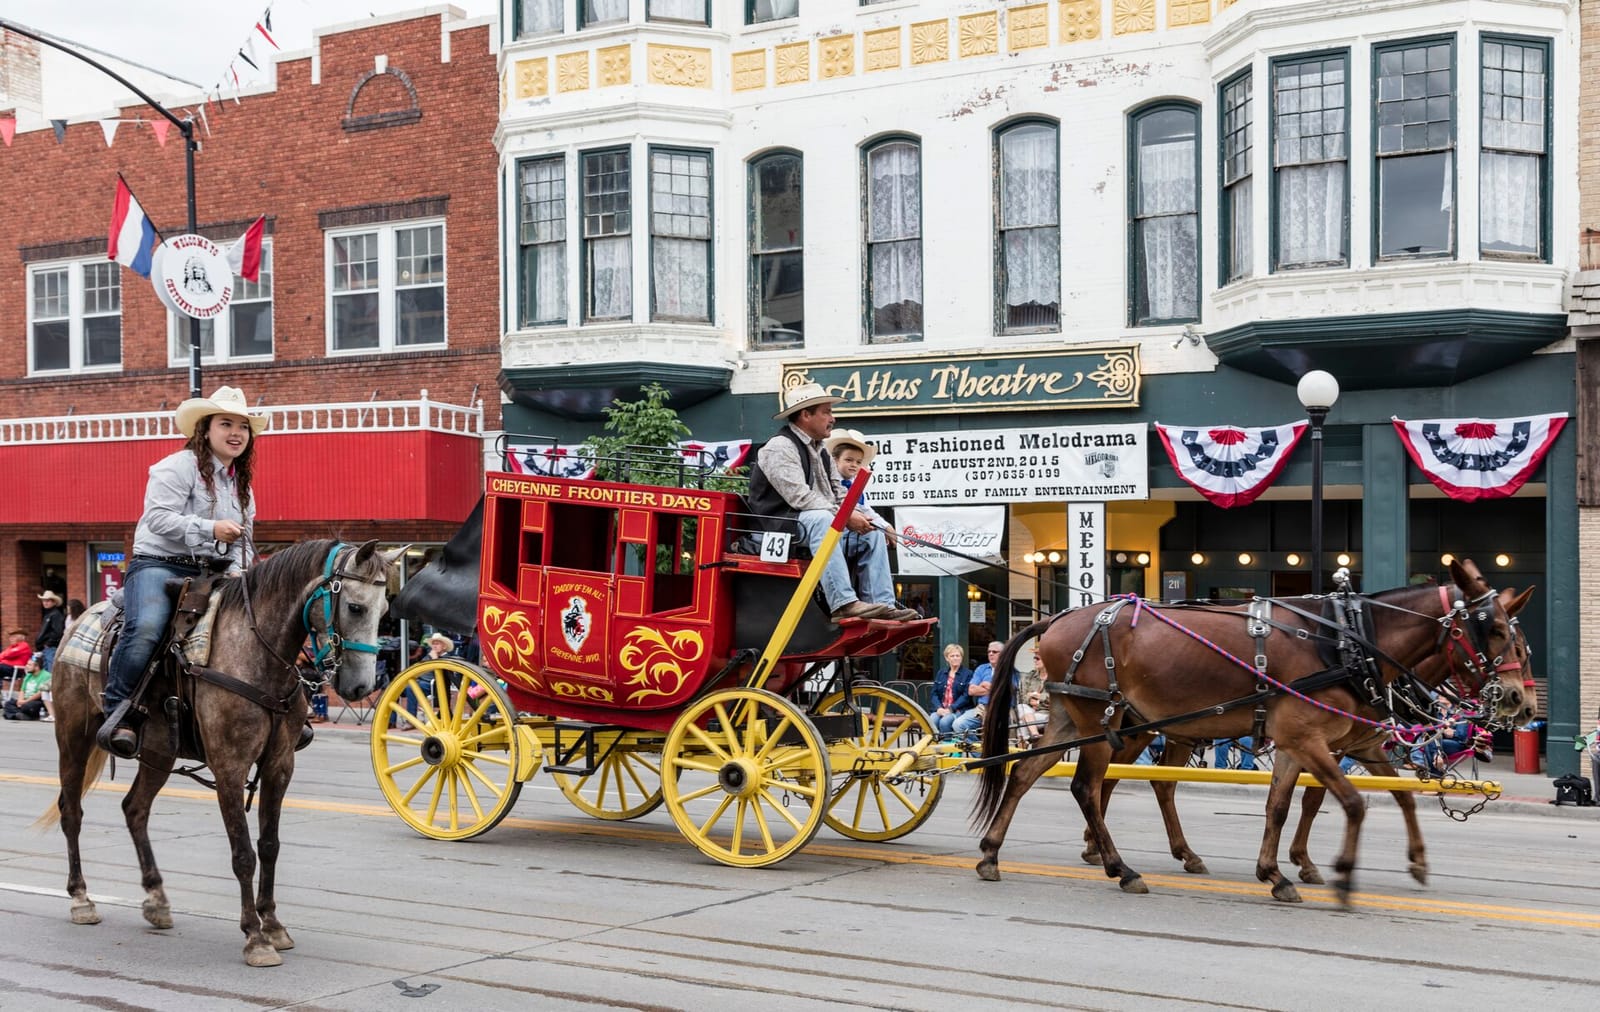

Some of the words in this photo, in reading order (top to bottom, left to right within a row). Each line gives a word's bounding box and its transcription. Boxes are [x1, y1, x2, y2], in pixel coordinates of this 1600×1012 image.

[825, 370, 922, 402] Atlas
[930, 363, 1083, 398] Theatre
[906, 435, 1005, 454] Fashioned
[1019, 432, 1137, 449] Melodrama
[886, 461, 912, 471] 9TH
[932, 459, 985, 469] AUGUST
[492, 479, 561, 497] CHEYENNE
[568, 486, 657, 506] FRONTIER
[662, 493, 711, 511] DAYS
[902, 490, 915, 499] 59
[923, 489, 958, 499] YEARS
[965, 488, 978, 497] OF
[985, 485, 1028, 498] FAMILY
[1035, 484, 1136, 496] ENTERTAINMENT
[766, 536, 785, 557] 43
[942, 531, 998, 547] LIGHT
[1168, 580, 1180, 589] 211
